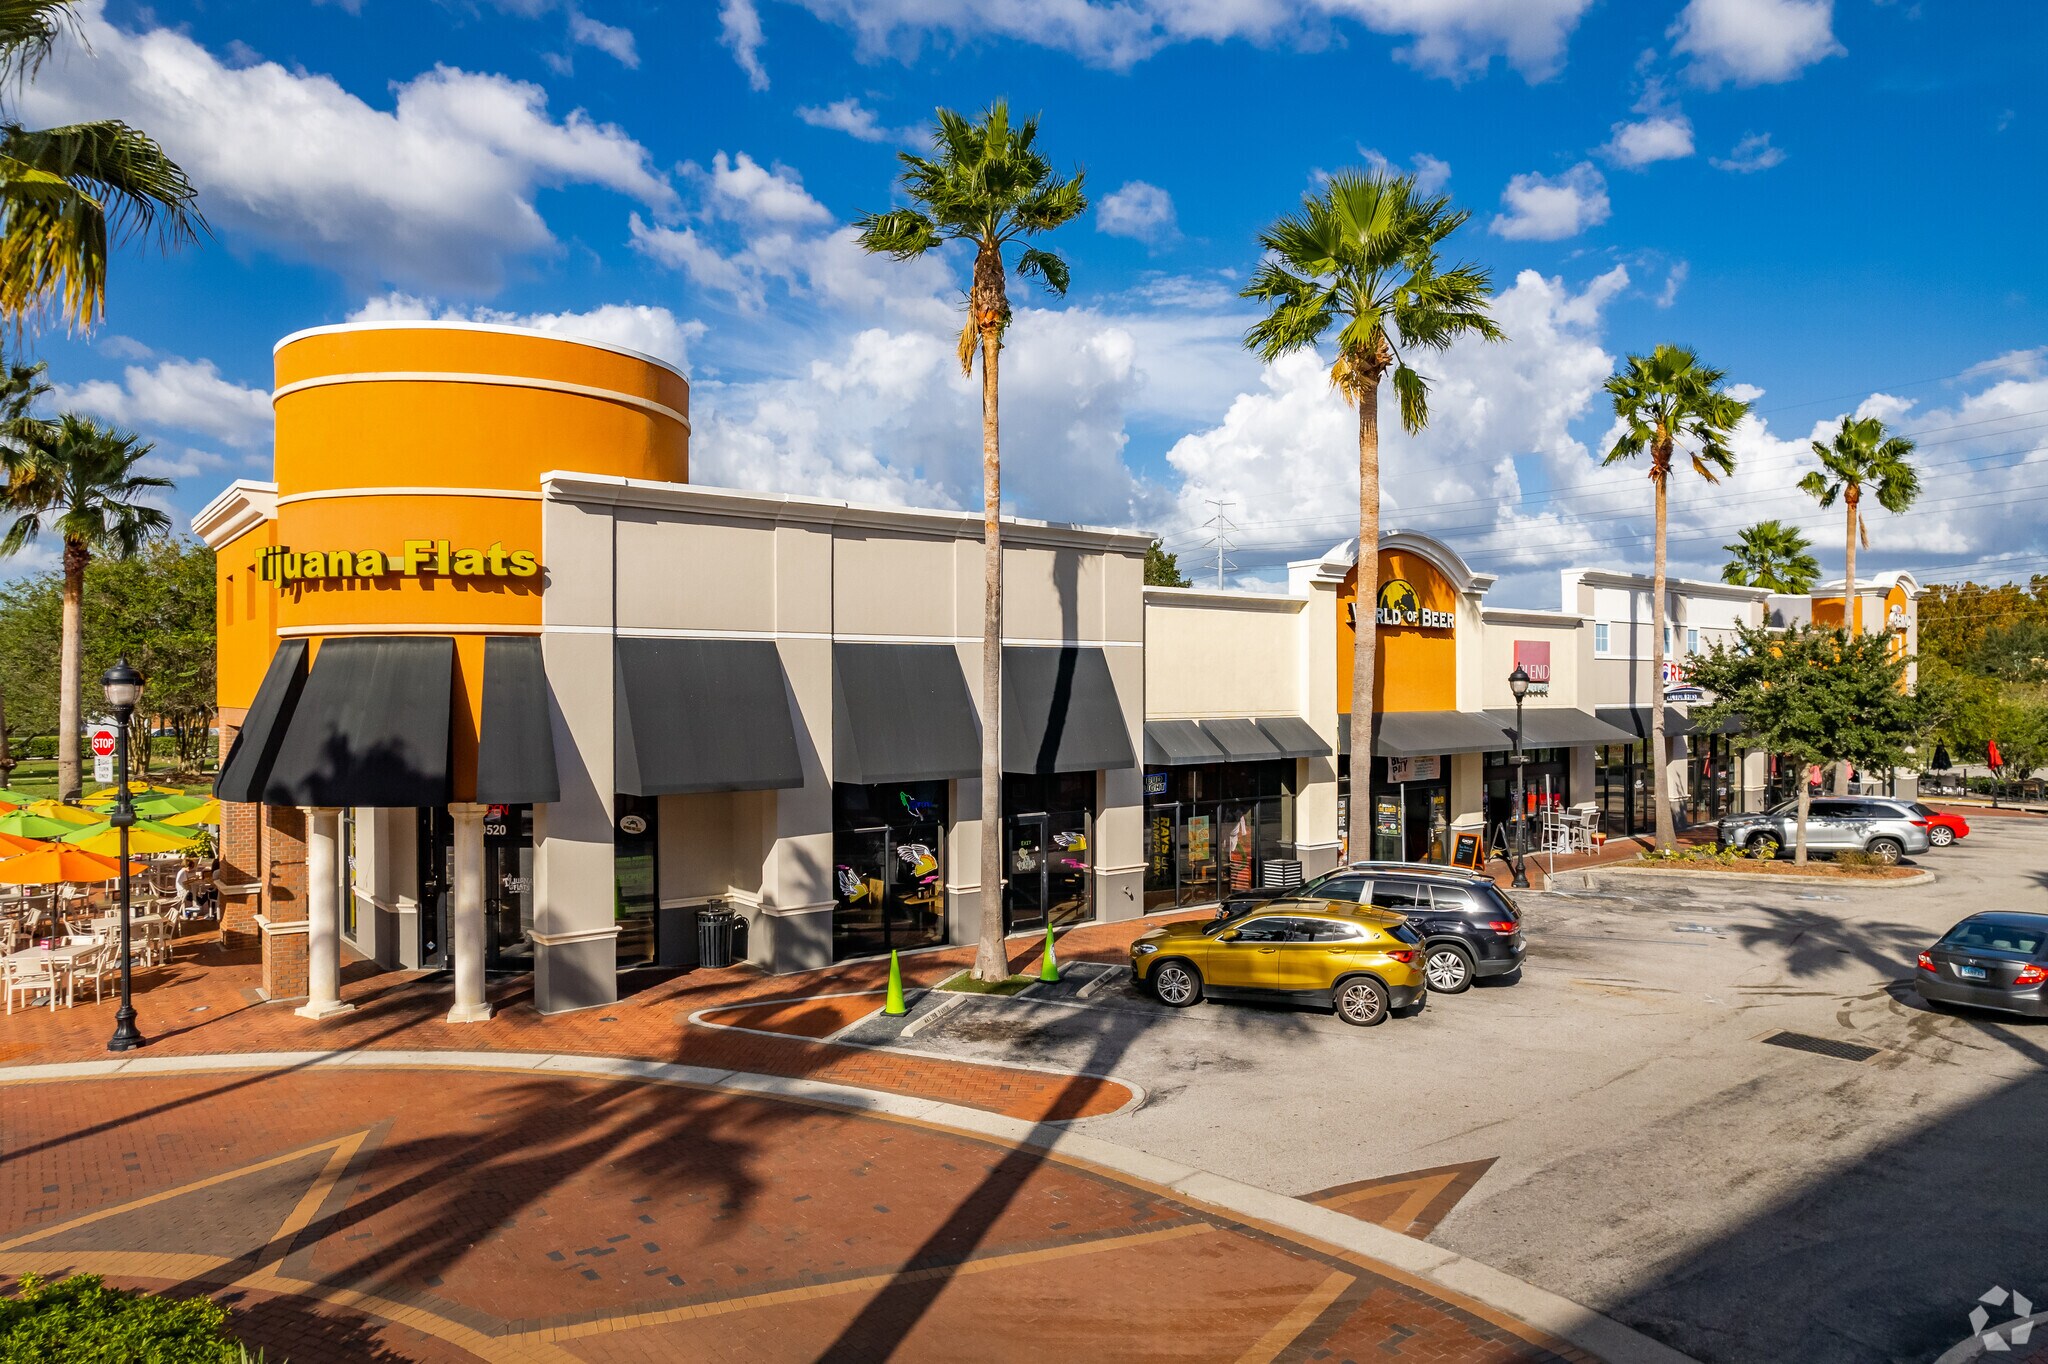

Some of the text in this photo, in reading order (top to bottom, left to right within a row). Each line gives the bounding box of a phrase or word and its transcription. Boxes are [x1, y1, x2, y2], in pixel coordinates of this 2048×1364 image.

[255, 540, 537, 588] Tijuana Flats
[1351, 602, 1455, 628] RLD OF BEER
[94, 738, 114, 749] STOP
[487, 804, 509, 815] PEN
[1152, 817, 1161, 853] TAMPA
[1160, 817, 1170, 854] RAYS
